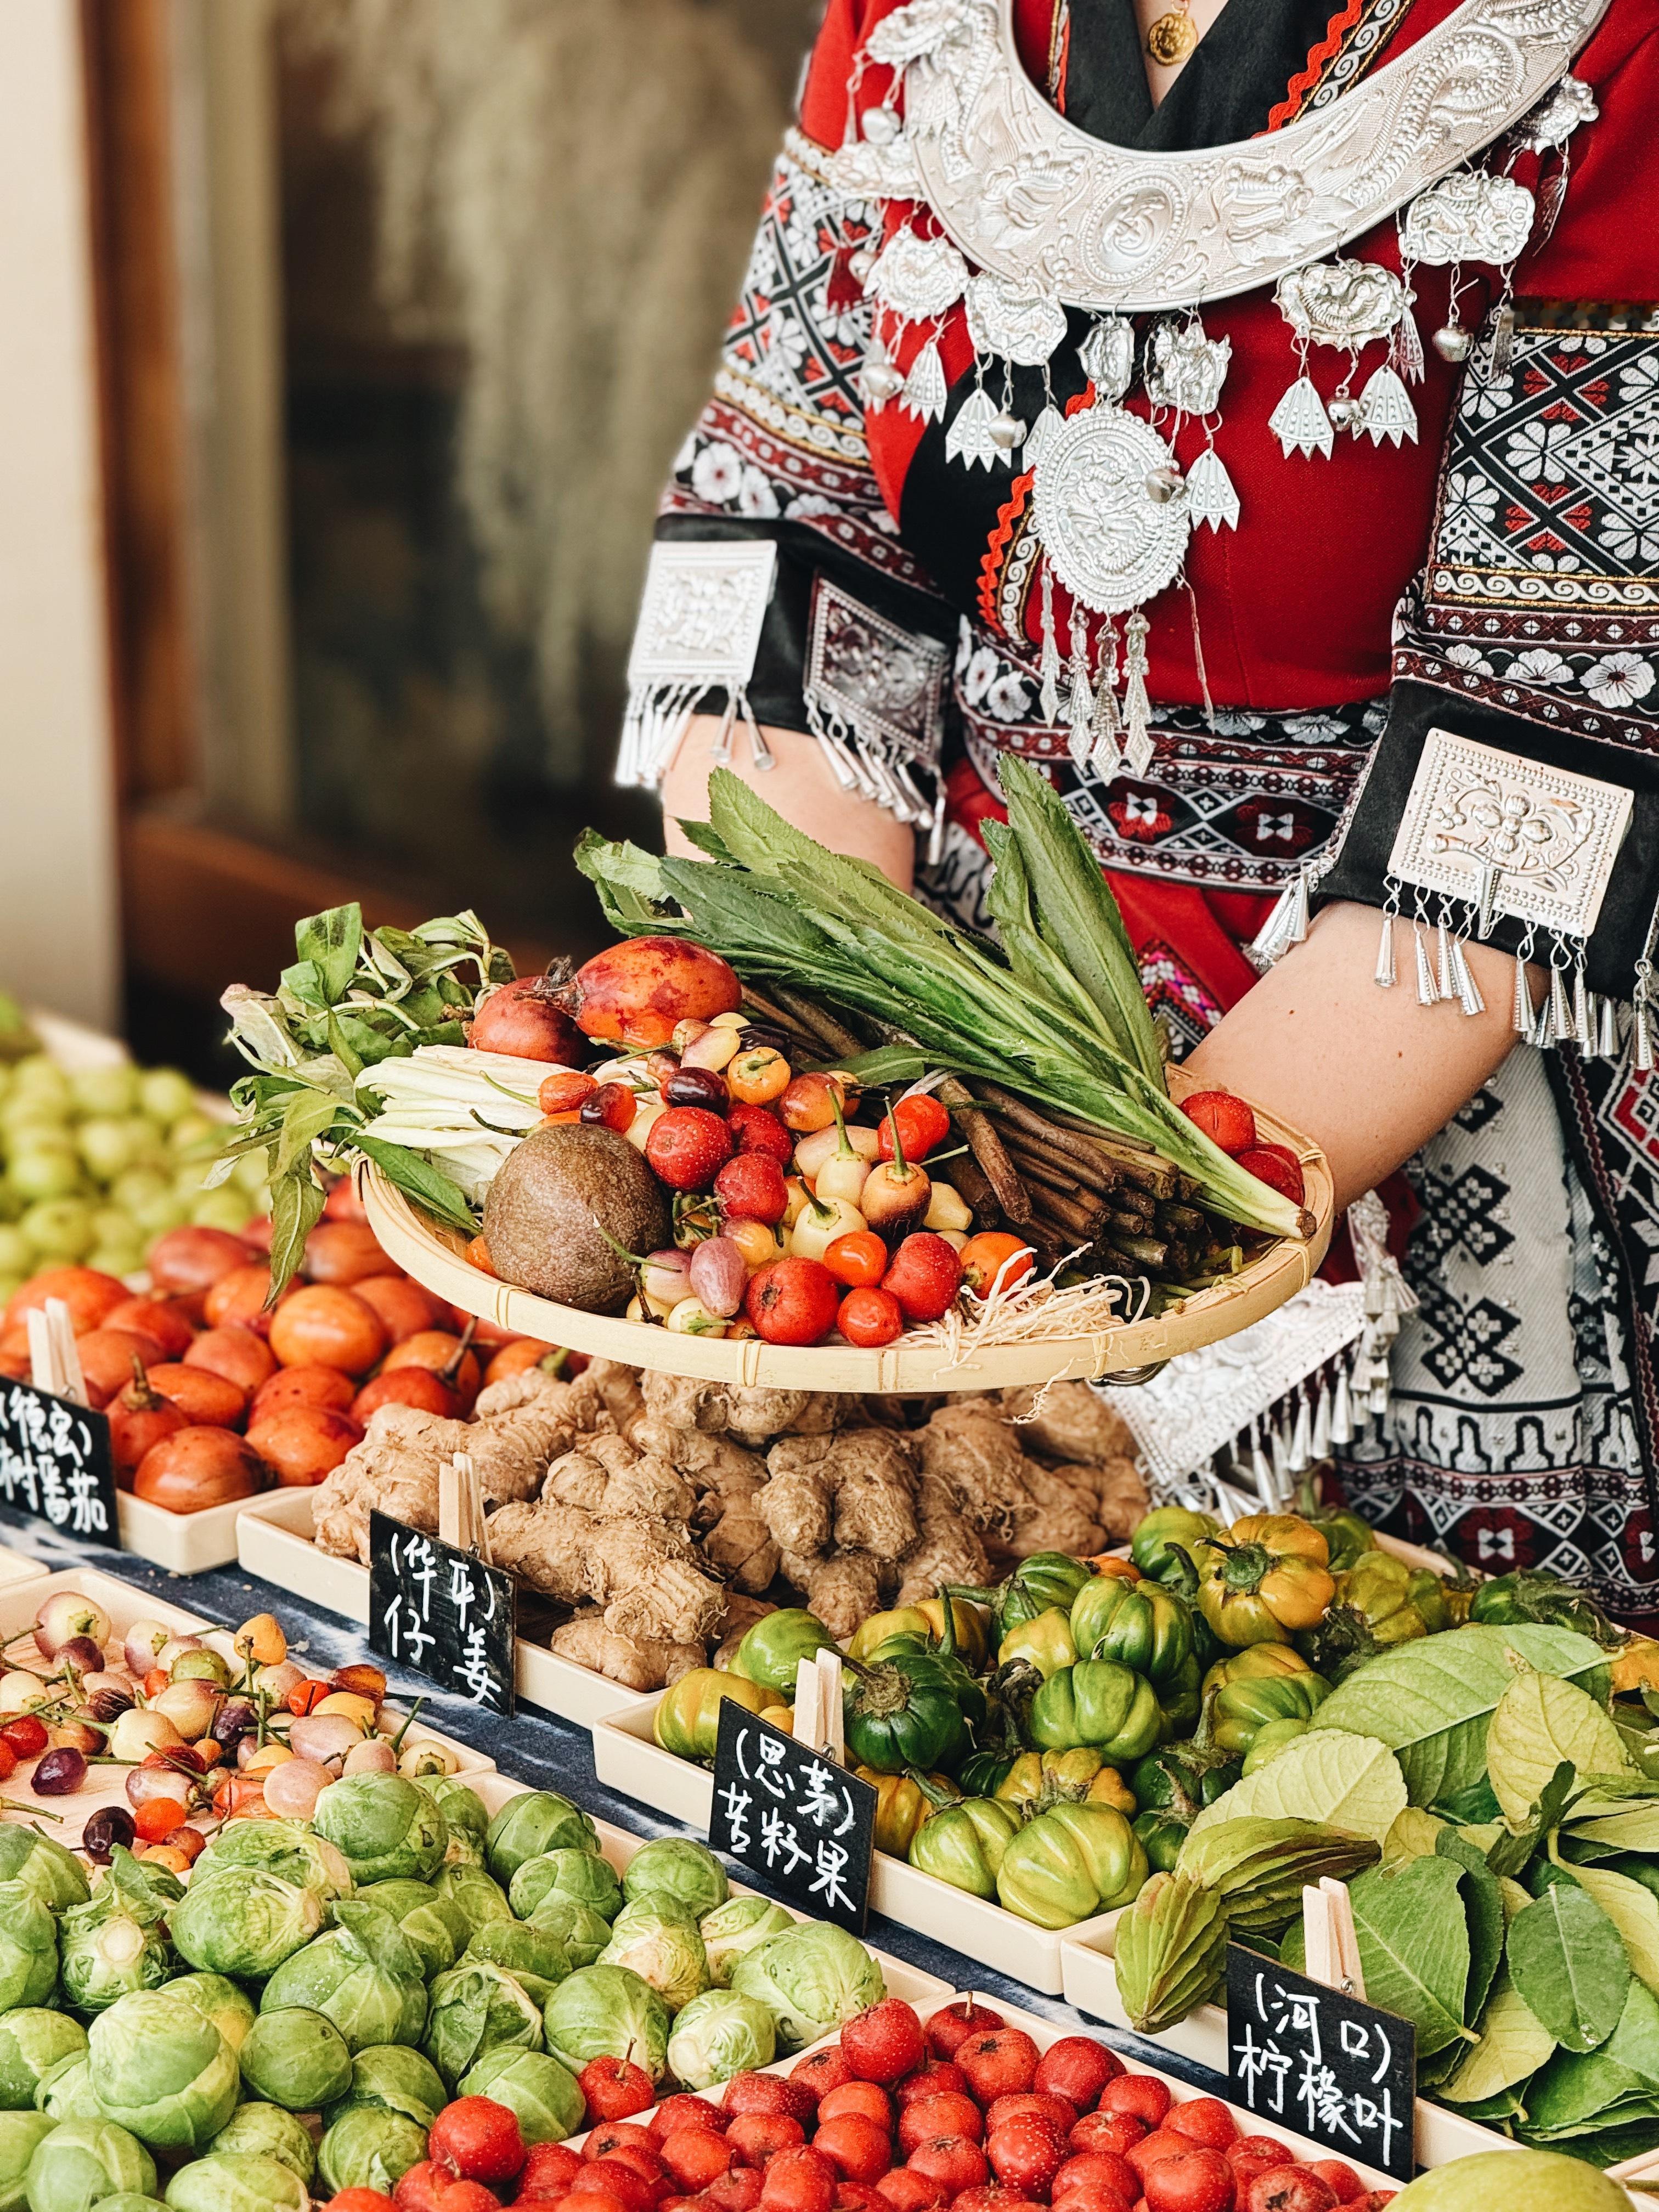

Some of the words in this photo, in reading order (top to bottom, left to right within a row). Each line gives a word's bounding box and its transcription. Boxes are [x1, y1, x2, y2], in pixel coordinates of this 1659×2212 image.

[384, 1594, 502, 1708] 仔姜
[1256, 1973, 1391, 2084] (河口)
[1233, 2024, 1403, 2166] 柠檬叶
